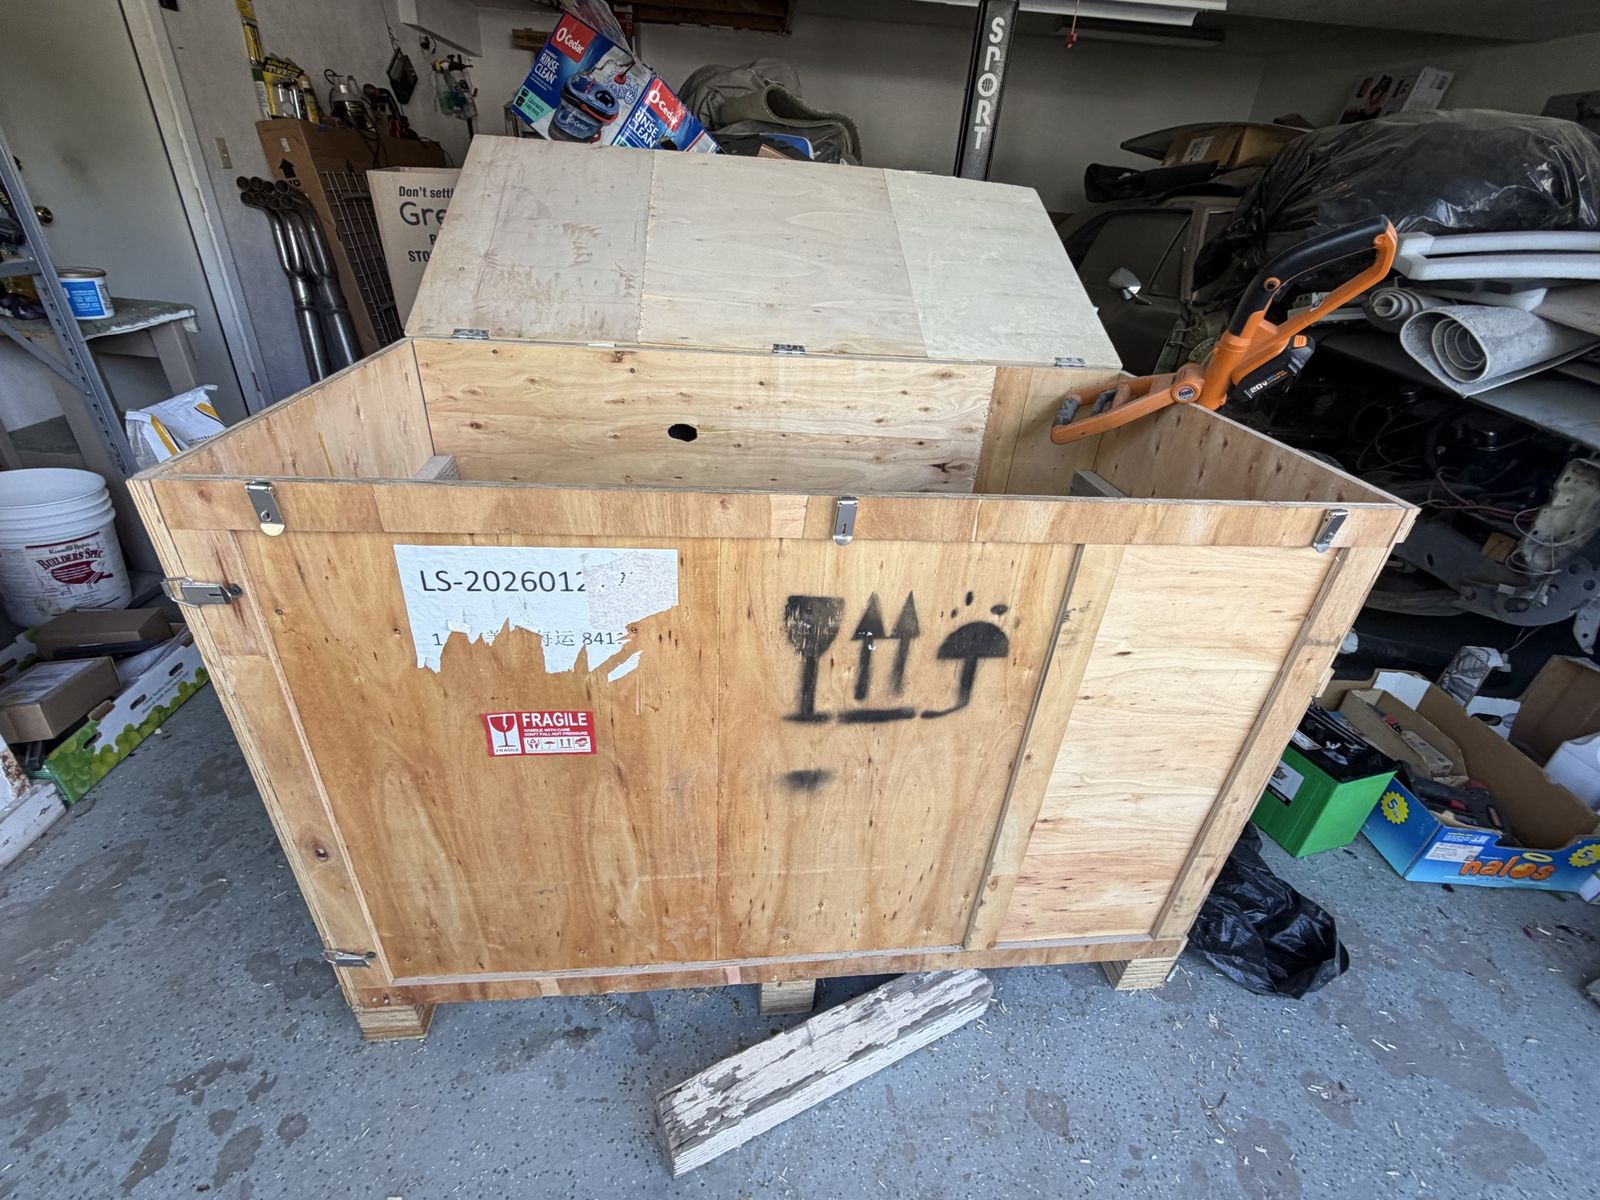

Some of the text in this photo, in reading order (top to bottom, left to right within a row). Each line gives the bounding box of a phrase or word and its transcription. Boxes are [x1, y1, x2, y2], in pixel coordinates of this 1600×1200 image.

[539, 52, 560, 72] RINSE
[534, 64, 557, 85] CLEAN
[973, 16, 1005, 150] SPORT
[399, 186, 427, 198] Don't
[408, 250, 432, 262] STO
[84, 547, 104, 560] SPEC
[521, 712, 588, 727] FRAGILE
[1387, 798, 1399, 810] 5
